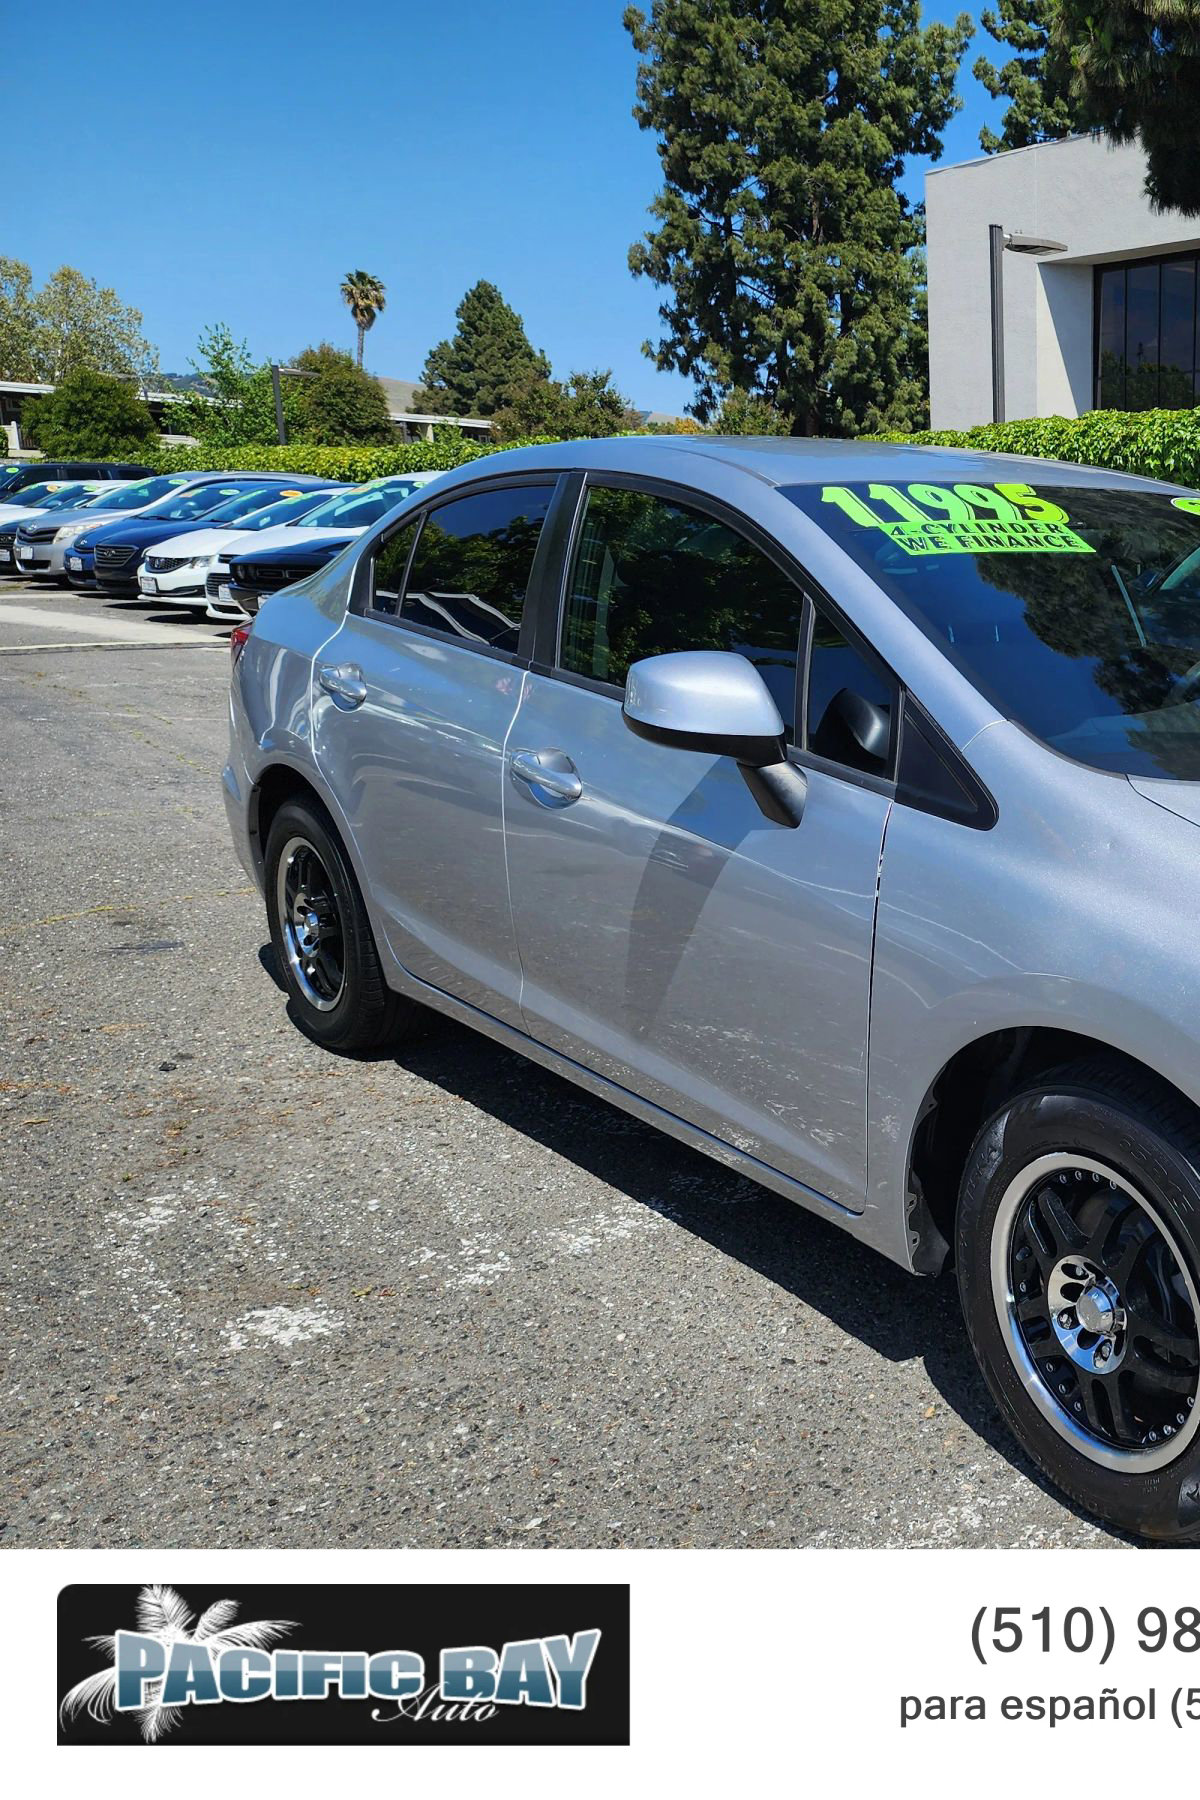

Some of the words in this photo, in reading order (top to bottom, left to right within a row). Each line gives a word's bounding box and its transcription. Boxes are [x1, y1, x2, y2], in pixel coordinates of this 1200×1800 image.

[822, 484, 1069, 527] 11995
[890, 523, 1066, 536] 4-CYLINDER
[902, 537, 950, 551] WE
[960, 534, 1081, 549] FINANCE
